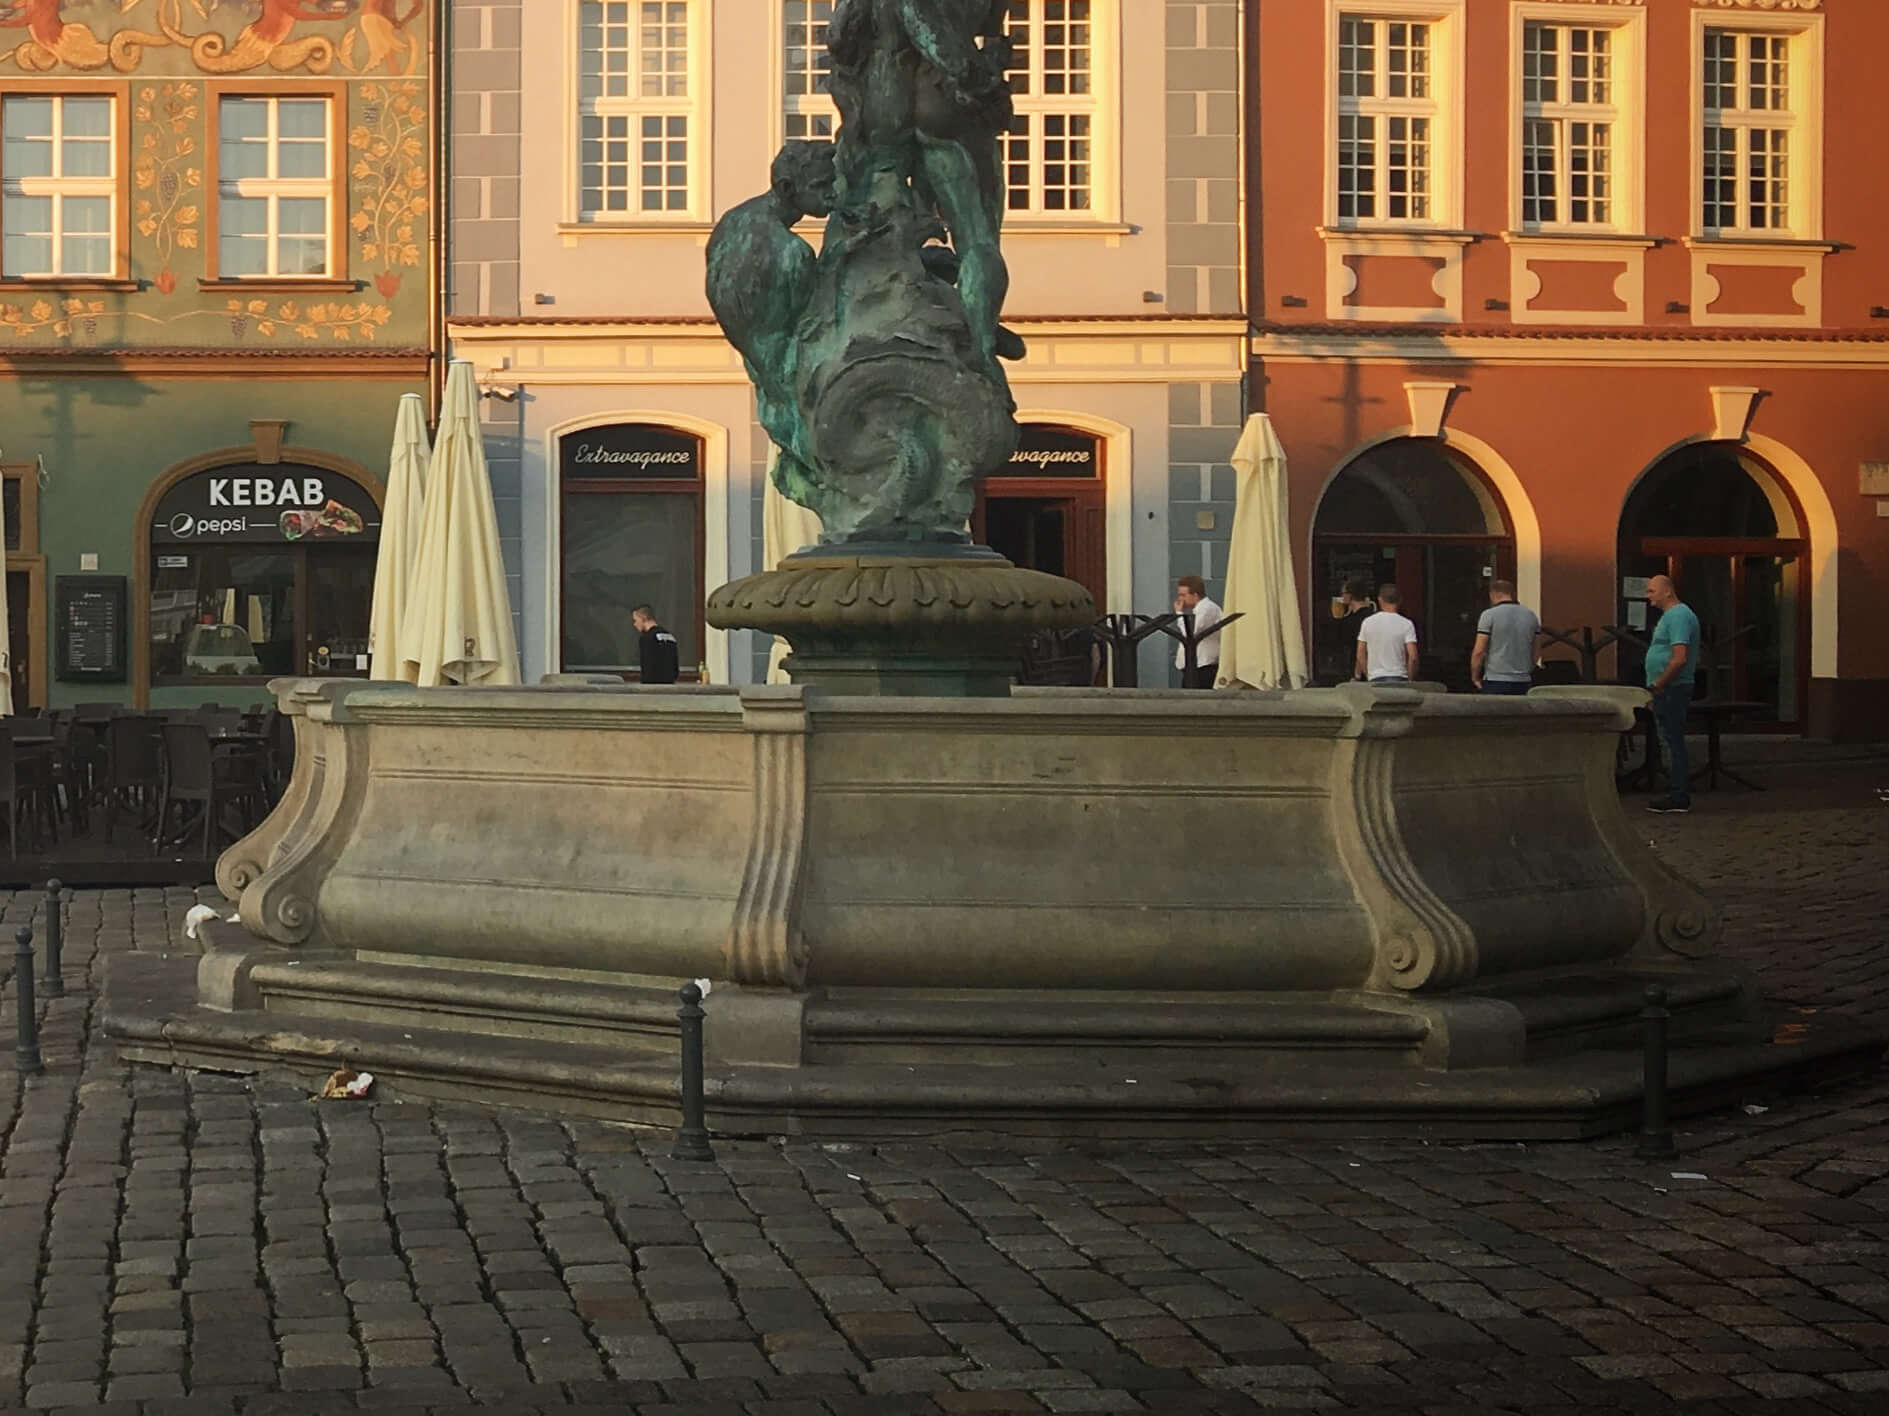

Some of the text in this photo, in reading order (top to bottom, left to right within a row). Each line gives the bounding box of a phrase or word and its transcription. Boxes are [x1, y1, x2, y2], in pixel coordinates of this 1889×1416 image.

[575, 444, 690, 470] Extravagance
[209, 479, 324, 506] KEBAB
[197, 517, 247, 535] pepsi
